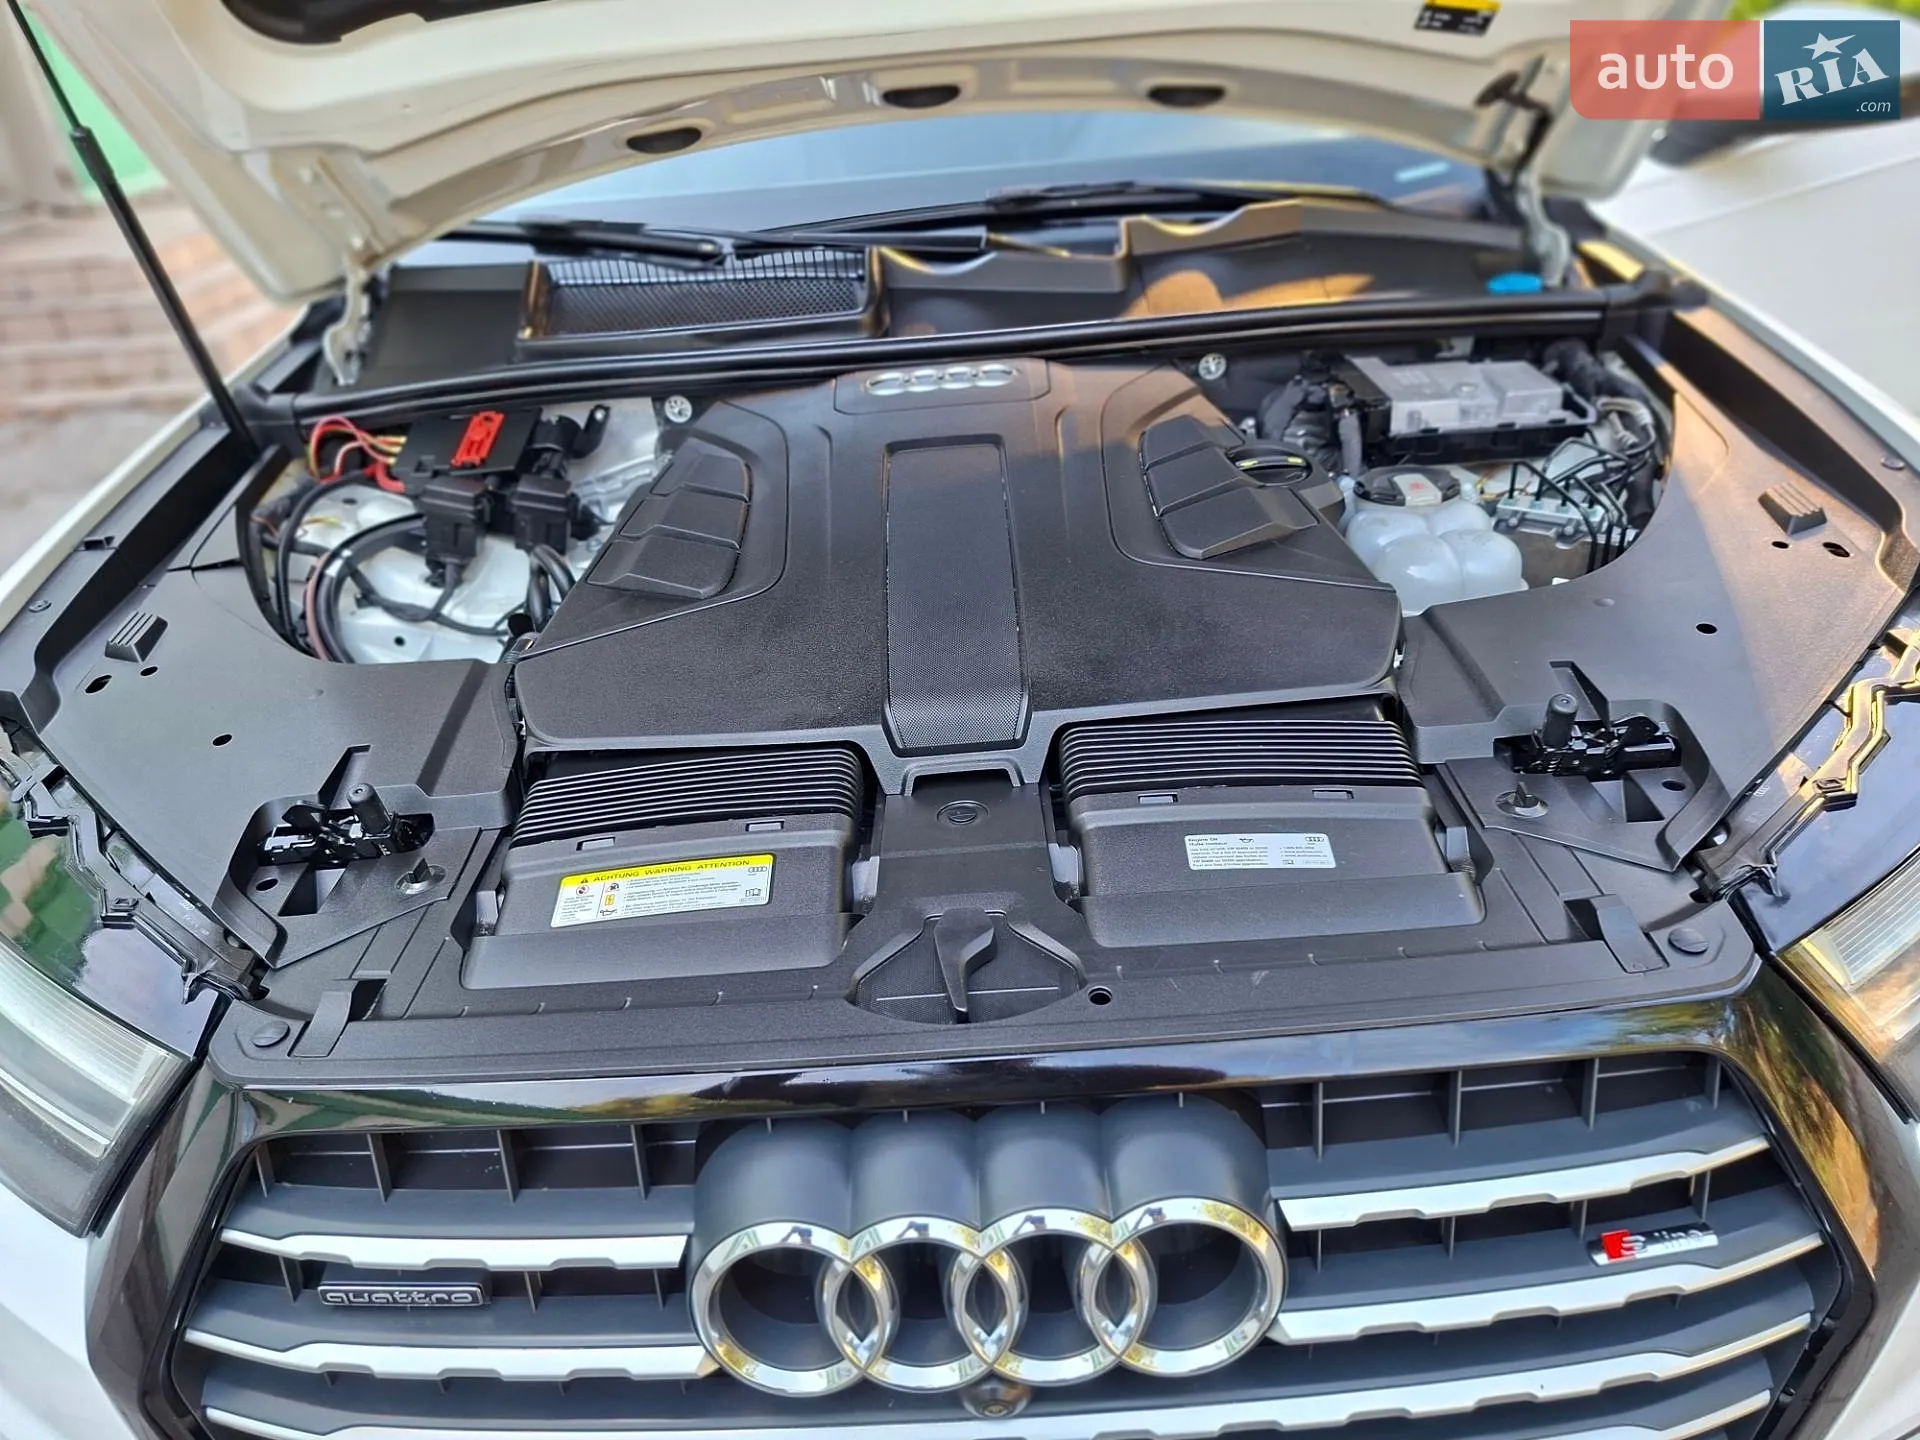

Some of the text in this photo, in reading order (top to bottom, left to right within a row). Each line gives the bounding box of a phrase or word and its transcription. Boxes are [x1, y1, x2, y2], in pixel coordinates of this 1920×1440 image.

[592, 859, 750, 882] ACHTUNG WARNING ATTENTION
[325, 1291, 472, 1305] quattro
